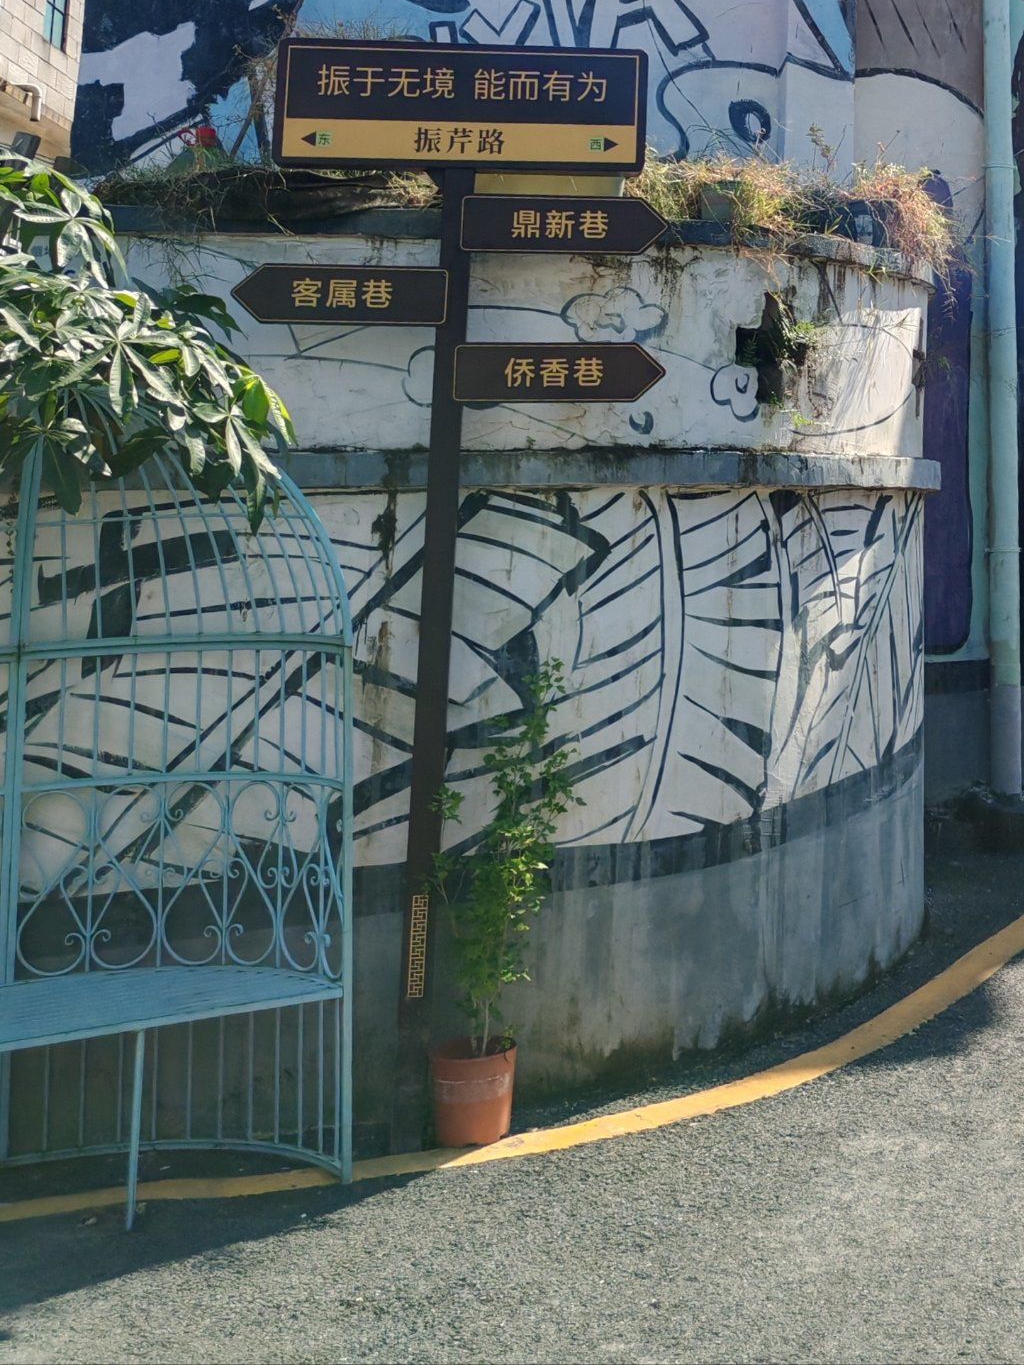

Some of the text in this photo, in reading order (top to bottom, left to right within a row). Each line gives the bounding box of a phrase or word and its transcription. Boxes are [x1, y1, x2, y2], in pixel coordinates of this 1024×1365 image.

[317, 63, 608, 102] 振于无境 能而有为
[317, 133, 331, 146] 东
[413, 127, 505, 155] 振芹路
[590, 138, 603, 151] 西
[511, 210, 609, 240] 鼎新巷
[291, 278, 394, 310] 客属巷
[504, 357, 604, 388] 侨香巷
